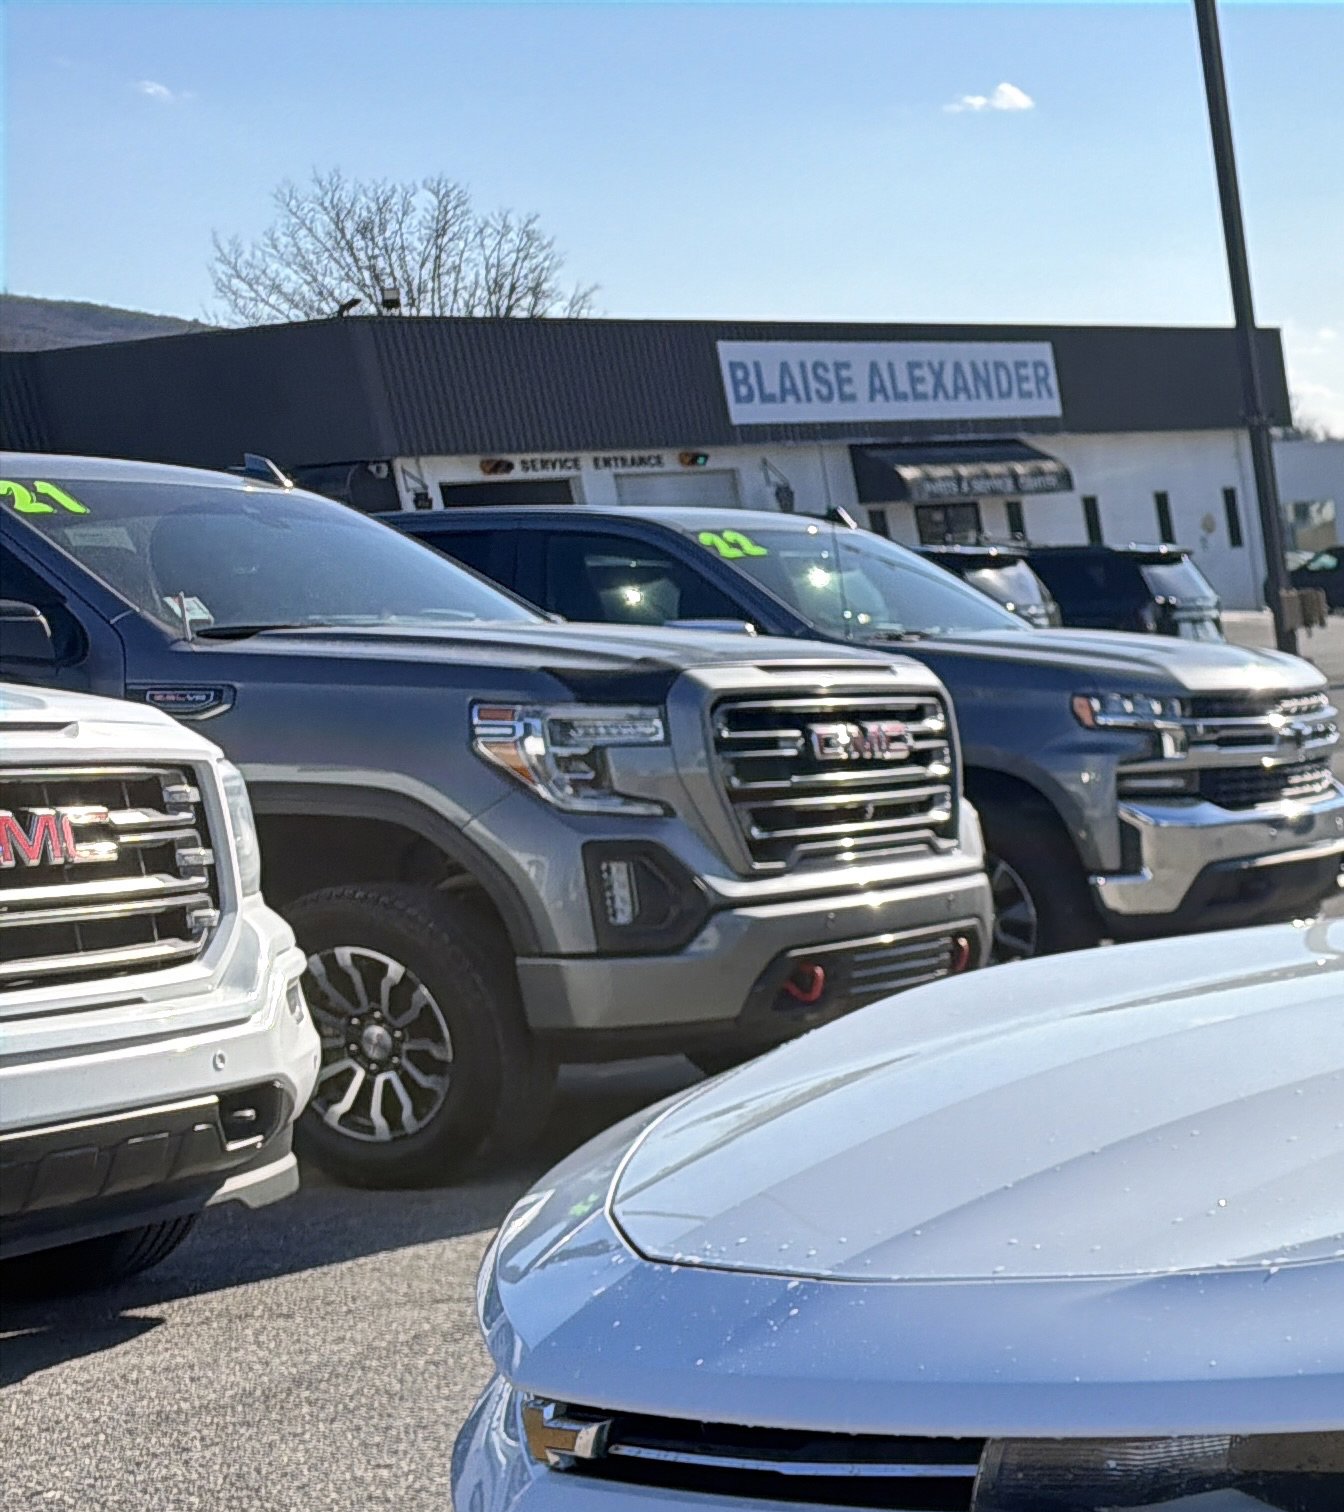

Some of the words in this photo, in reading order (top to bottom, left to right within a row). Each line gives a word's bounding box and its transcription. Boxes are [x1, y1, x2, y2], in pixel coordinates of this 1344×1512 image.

[728, 359, 857, 405] BLAISE
[868, 359, 1053, 403] ALEXANDER
[520, 457, 582, 473] SERVICE
[593, 454, 665, 470] ENTRANCE
[698, 529, 768, 558] 22
[808, 721, 912, 760] GMC
[0, 806, 118, 868] MC
